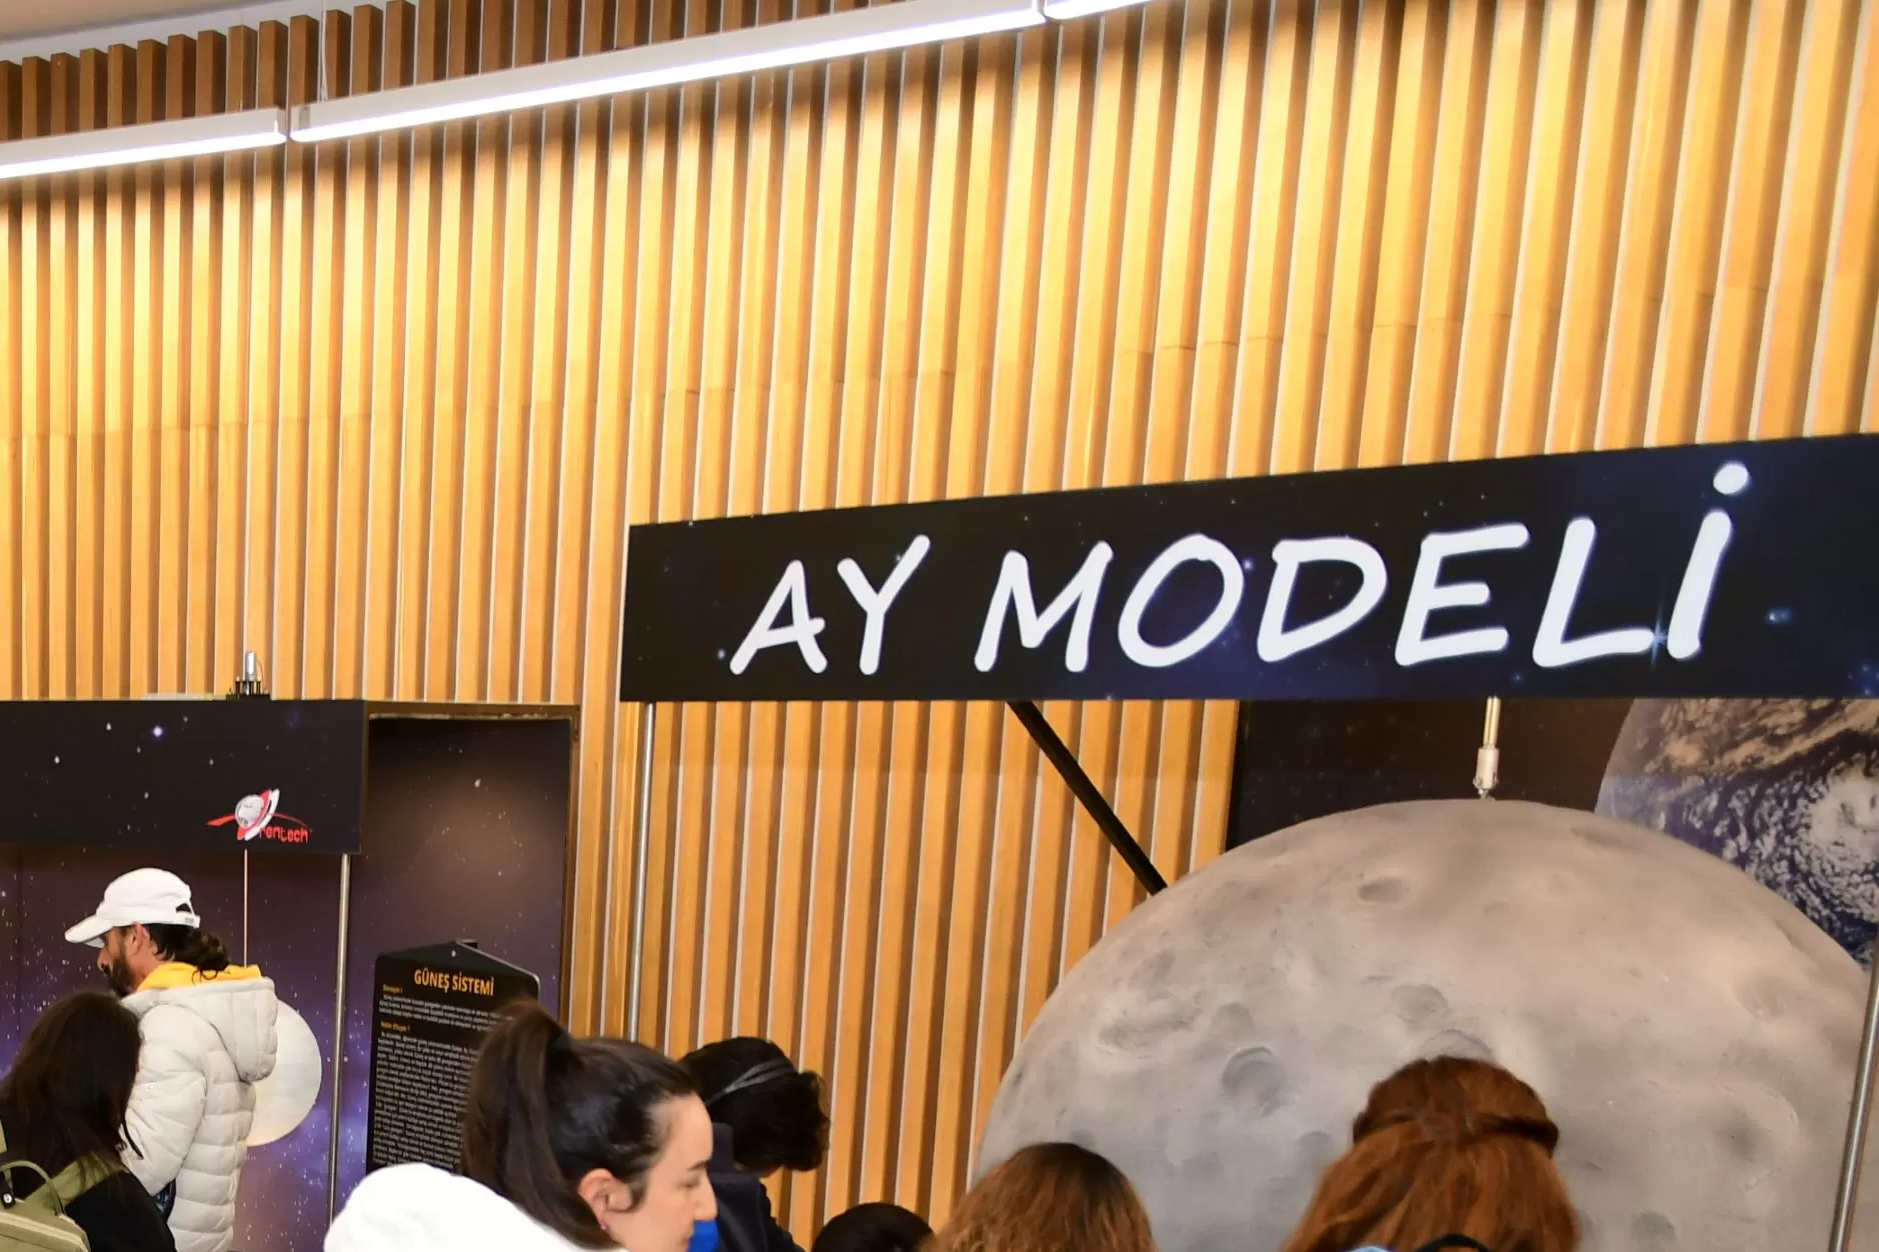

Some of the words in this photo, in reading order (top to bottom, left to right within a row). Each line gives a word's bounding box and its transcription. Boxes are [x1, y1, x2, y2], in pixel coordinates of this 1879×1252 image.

[728, 533, 931, 676] AY
[973, 461, 1750, 675] MODELİ
[414, 967, 450, 993] GÜNEŞ
[452, 971, 494, 996] SİSTEMİ
